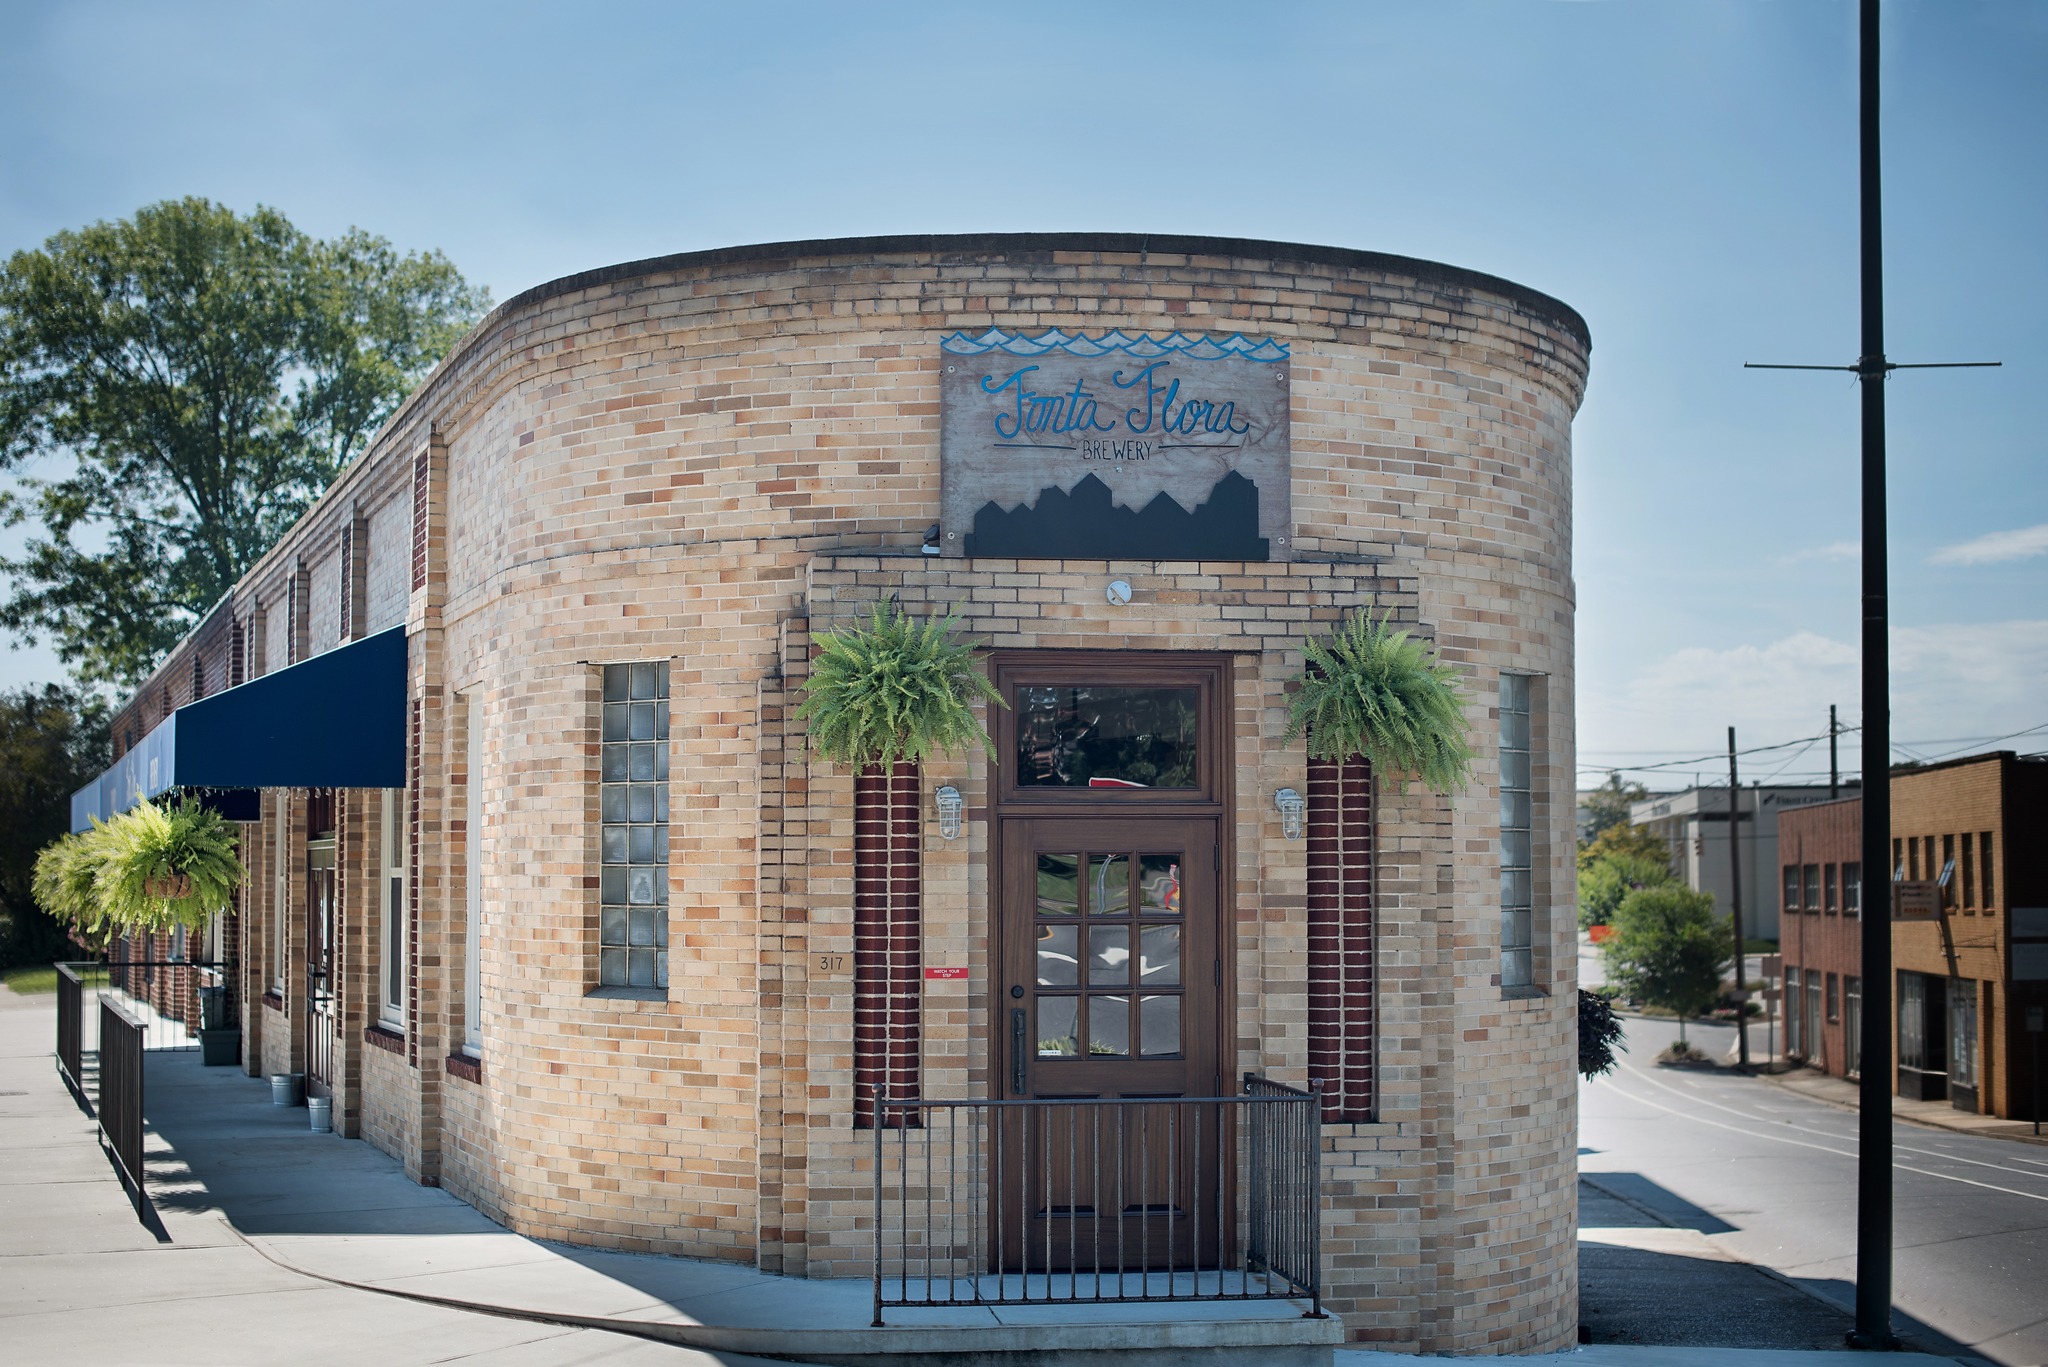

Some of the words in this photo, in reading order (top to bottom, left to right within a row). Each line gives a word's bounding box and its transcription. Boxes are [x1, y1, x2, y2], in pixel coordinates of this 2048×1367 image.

[981, 365, 1116, 439] Fonta
[1112, 361, 1250, 435] Flora
[1082, 440, 1153, 461] BREWERY
[820, 956, 843, 970] 317
